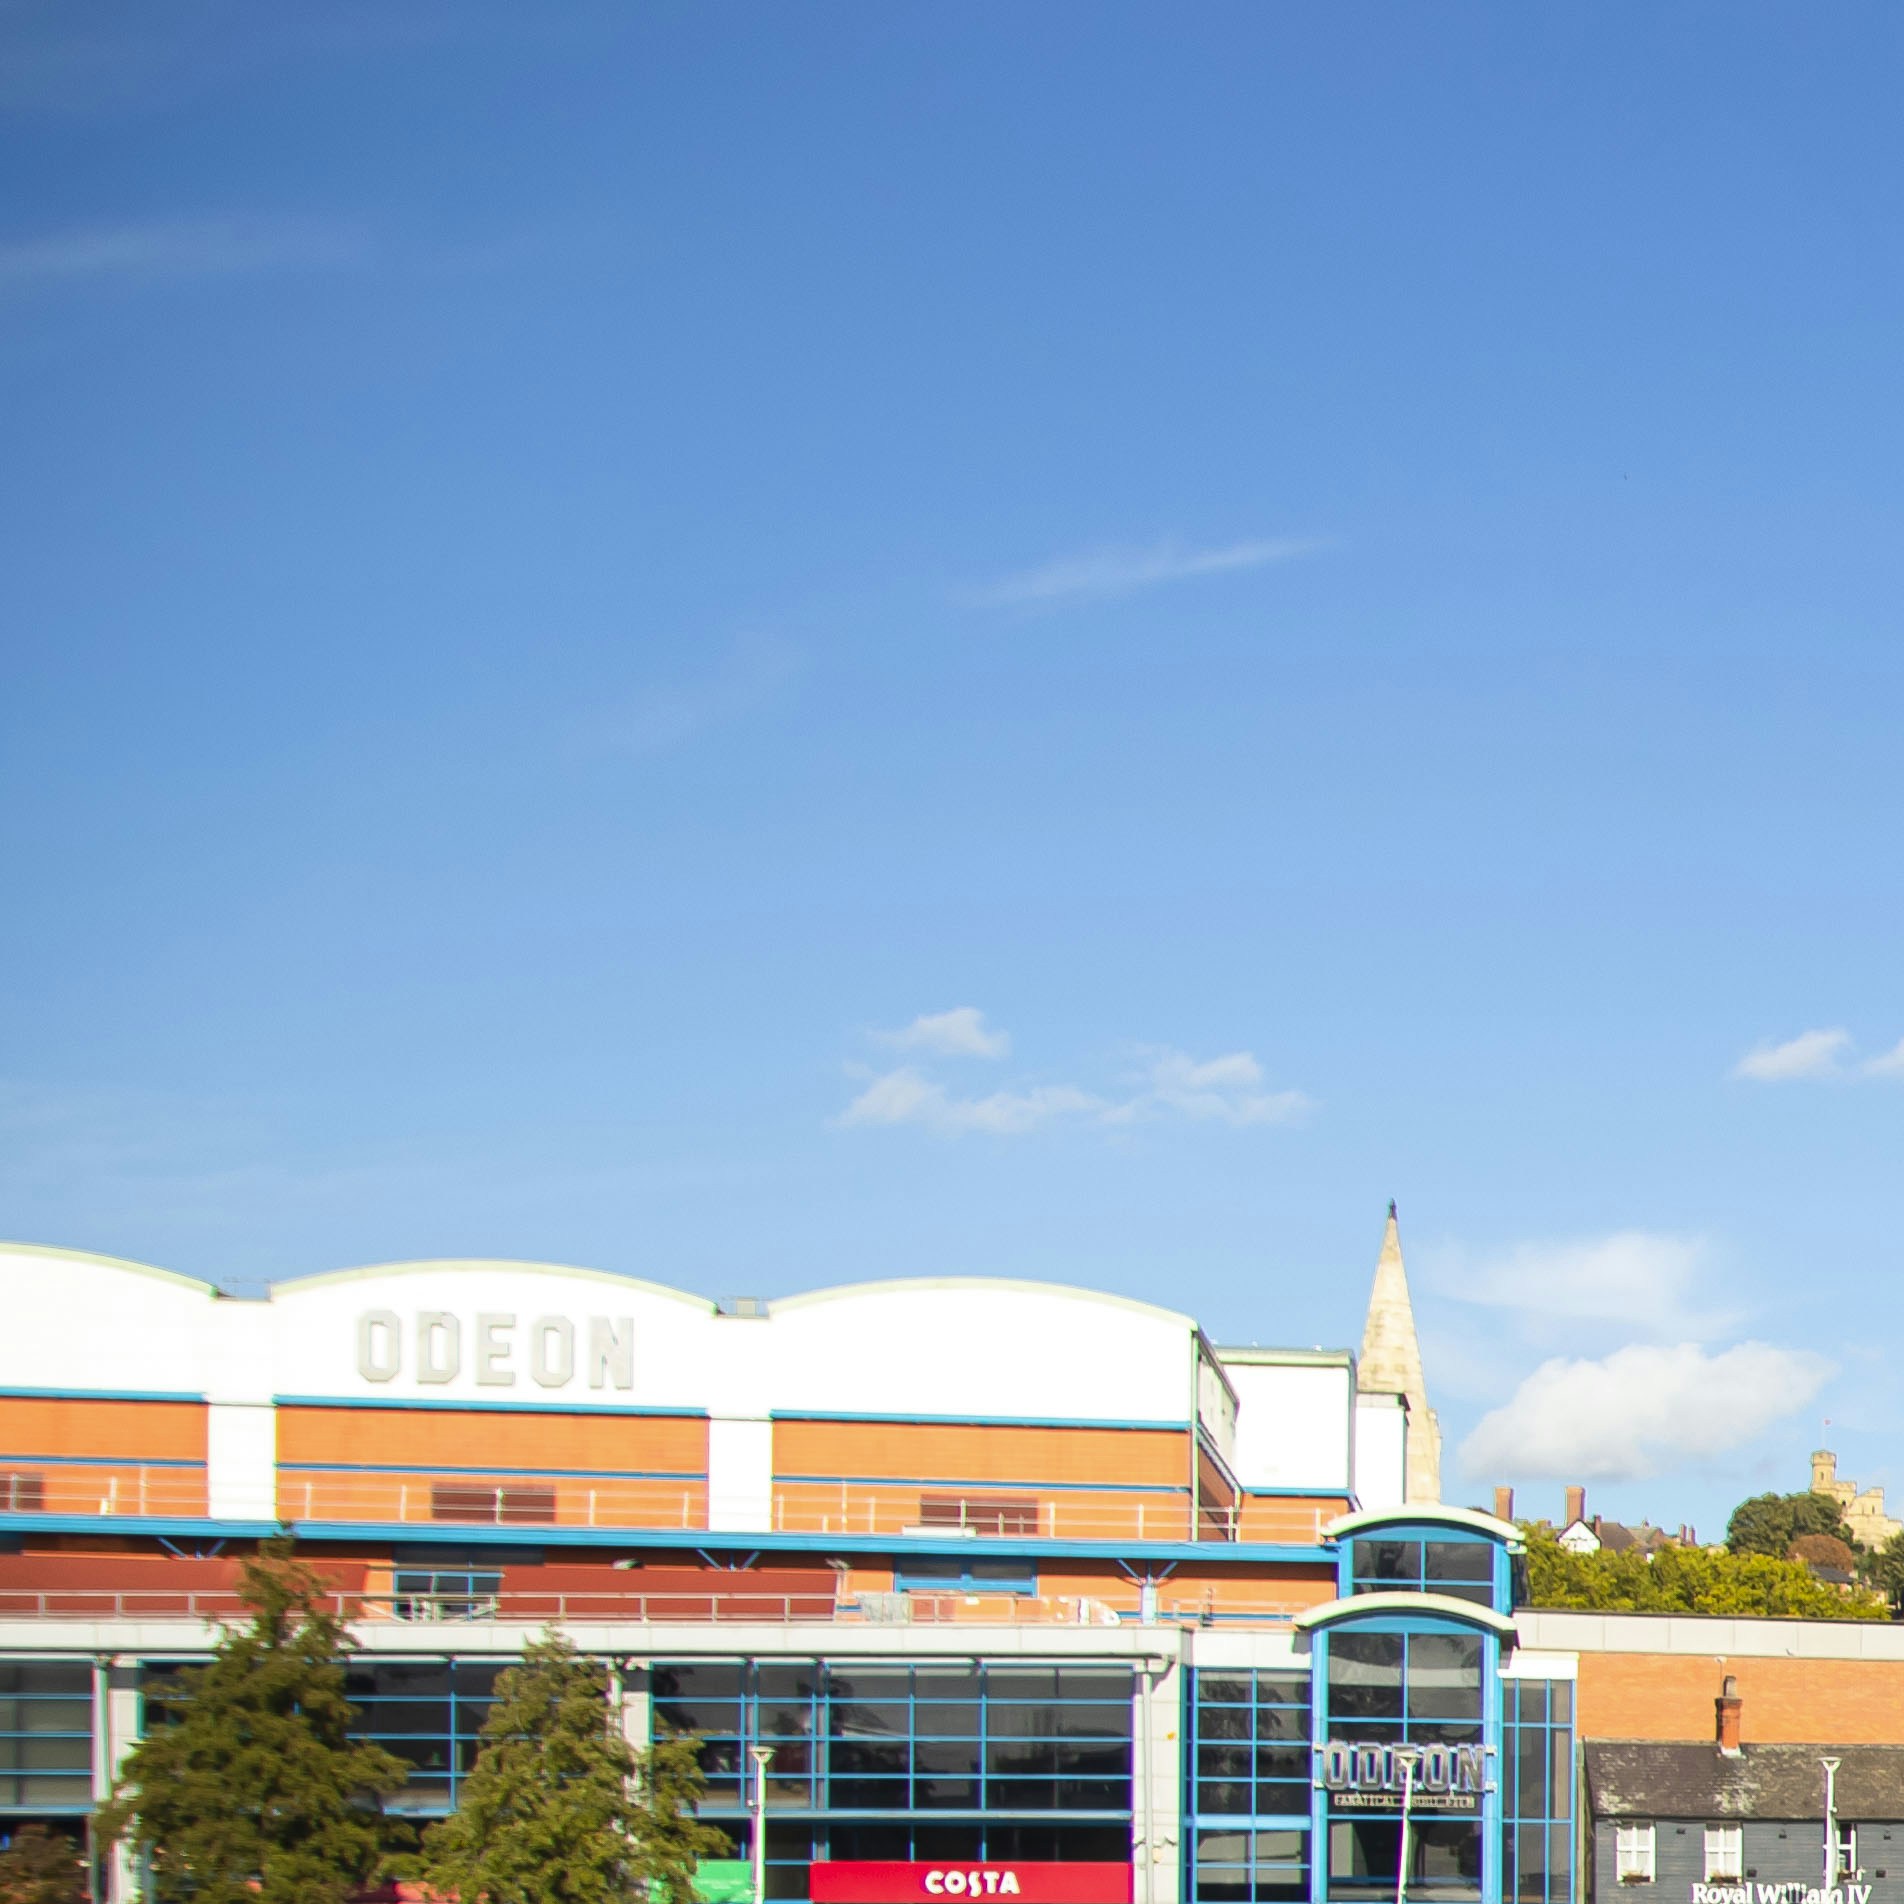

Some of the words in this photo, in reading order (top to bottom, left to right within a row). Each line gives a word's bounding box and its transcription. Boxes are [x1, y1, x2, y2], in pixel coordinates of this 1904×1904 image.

[357, 1309, 634, 1390] ODEON
[925, 1870, 1020, 1898] COSTA
[1756, 1882, 1844, 1904] William
[1848, 1885, 1872, 1904] IV
